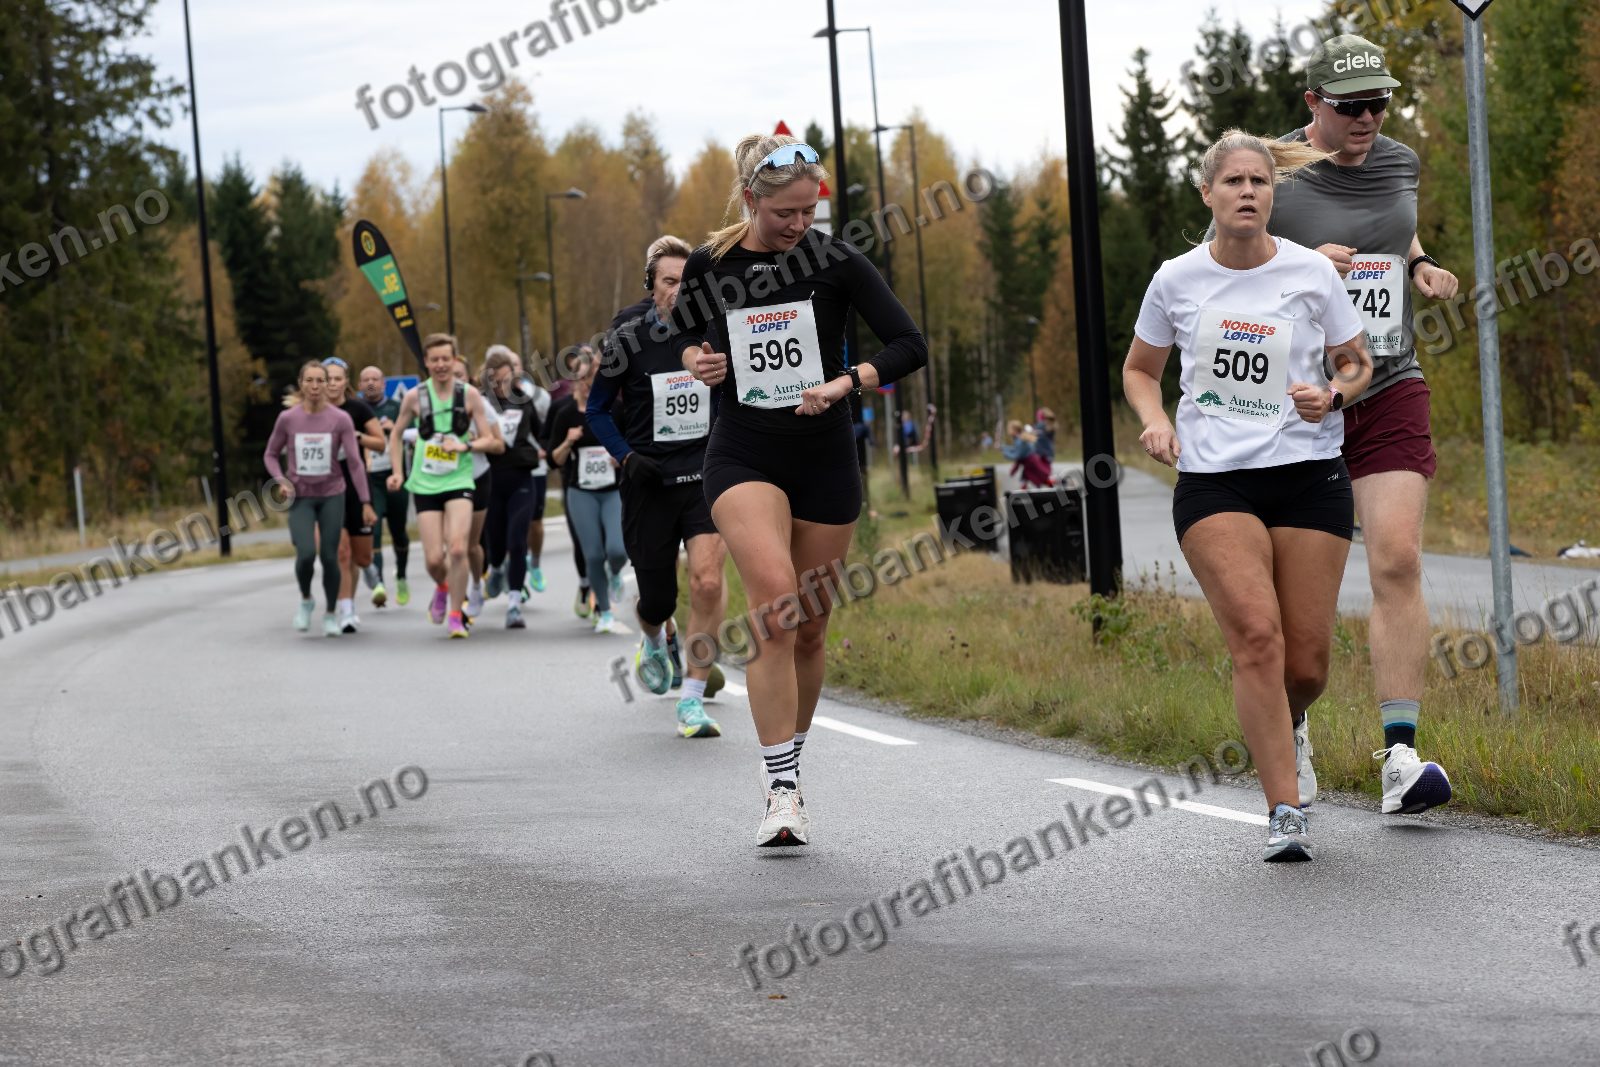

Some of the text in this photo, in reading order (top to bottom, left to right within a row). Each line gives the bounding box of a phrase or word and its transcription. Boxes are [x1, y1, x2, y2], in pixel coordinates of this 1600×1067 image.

[1333, 51, 1382, 74] ciele
[1350, 261, 1392, 271] NORGES
[1351, 270, 1386, 281] LØPET
[1347, 287, 1391, 318] 742
[745, 309, 798, 325] NORGES
[751, 320, 791, 334] LØPET
[1219, 319, 1277, 336] NORGES
[1222, 329, 1266, 344] LØPET
[749, 337, 803, 373] 596
[1212, 347, 1269, 385] 509
[666, 374, 696, 385] NORGE
[669, 381, 694, 391] LØPET
[665, 393, 700, 416] 599
[1229, 394, 1281, 415] Aurskog
[302, 447, 325, 460] 975
[585, 461, 608, 475] 808
